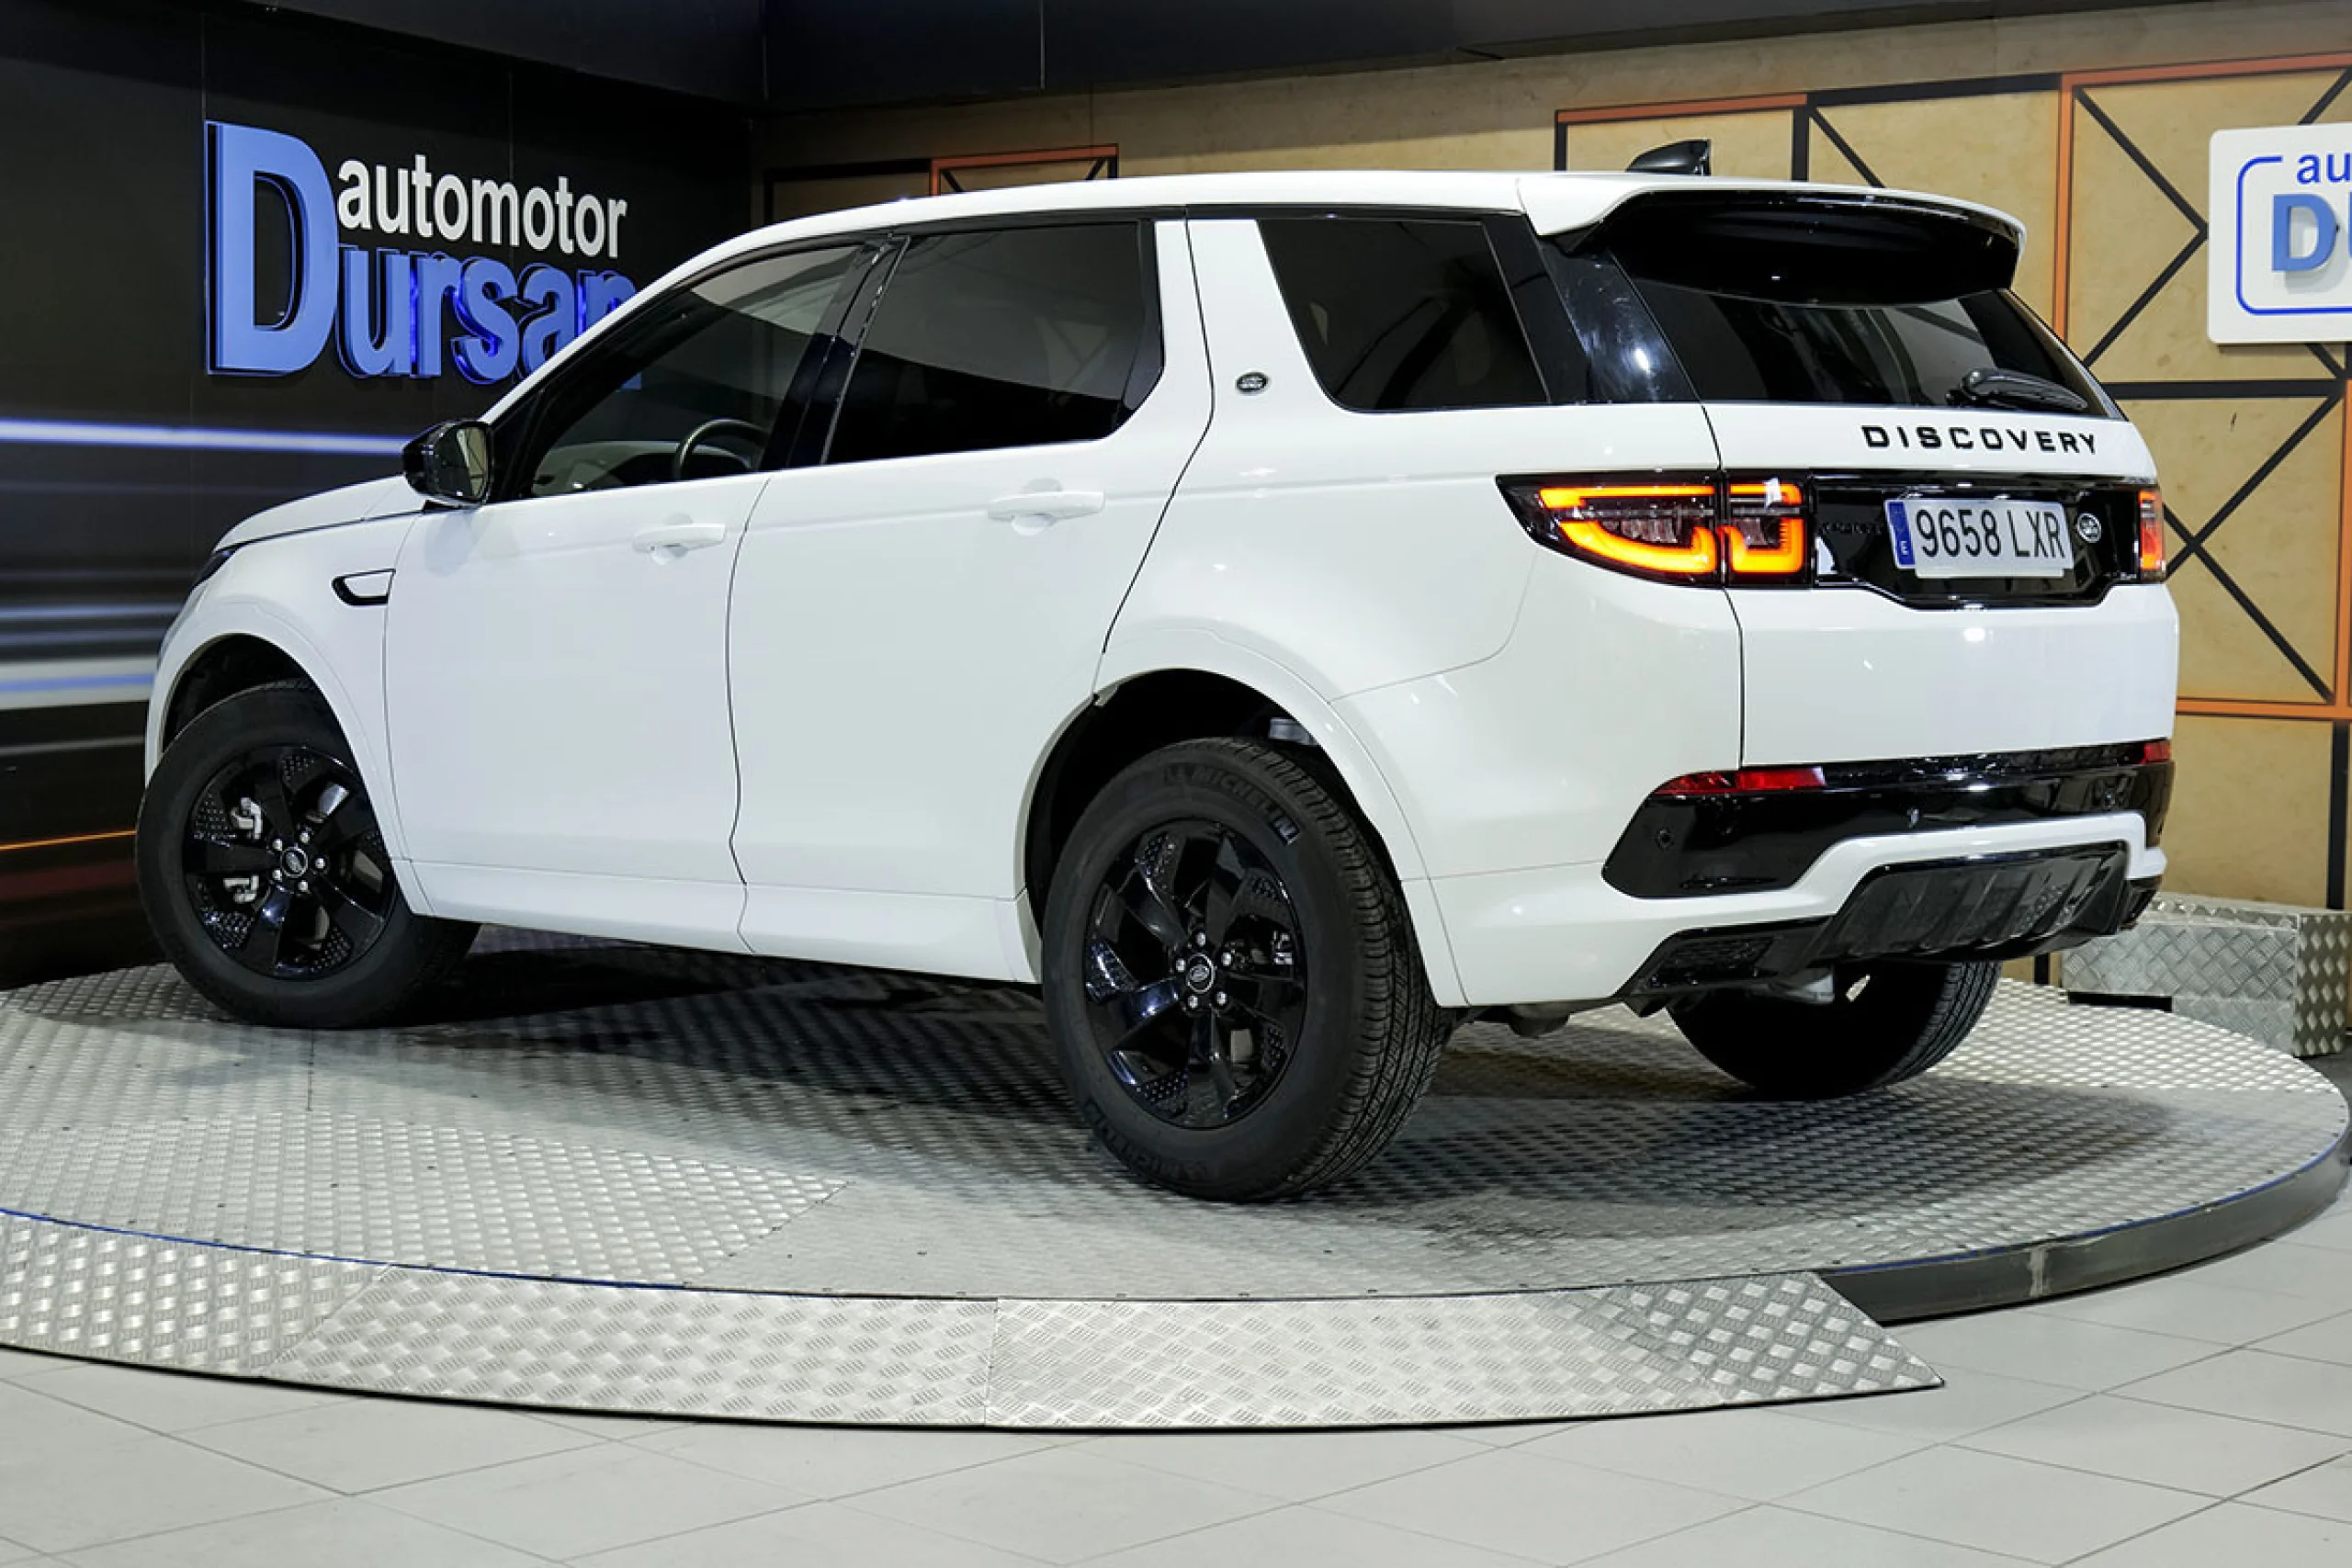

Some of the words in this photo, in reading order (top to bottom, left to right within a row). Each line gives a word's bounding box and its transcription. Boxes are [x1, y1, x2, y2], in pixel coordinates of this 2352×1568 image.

[337, 154, 628, 258] automotor
[2272, 191, 2352, 273] D
[1861, 424, 2097, 455] DISCOVERY
[1899, 540, 1909, 555] E
[1916, 509, 2001, 558] 9658
[2007, 509, 2066, 558] LXR
